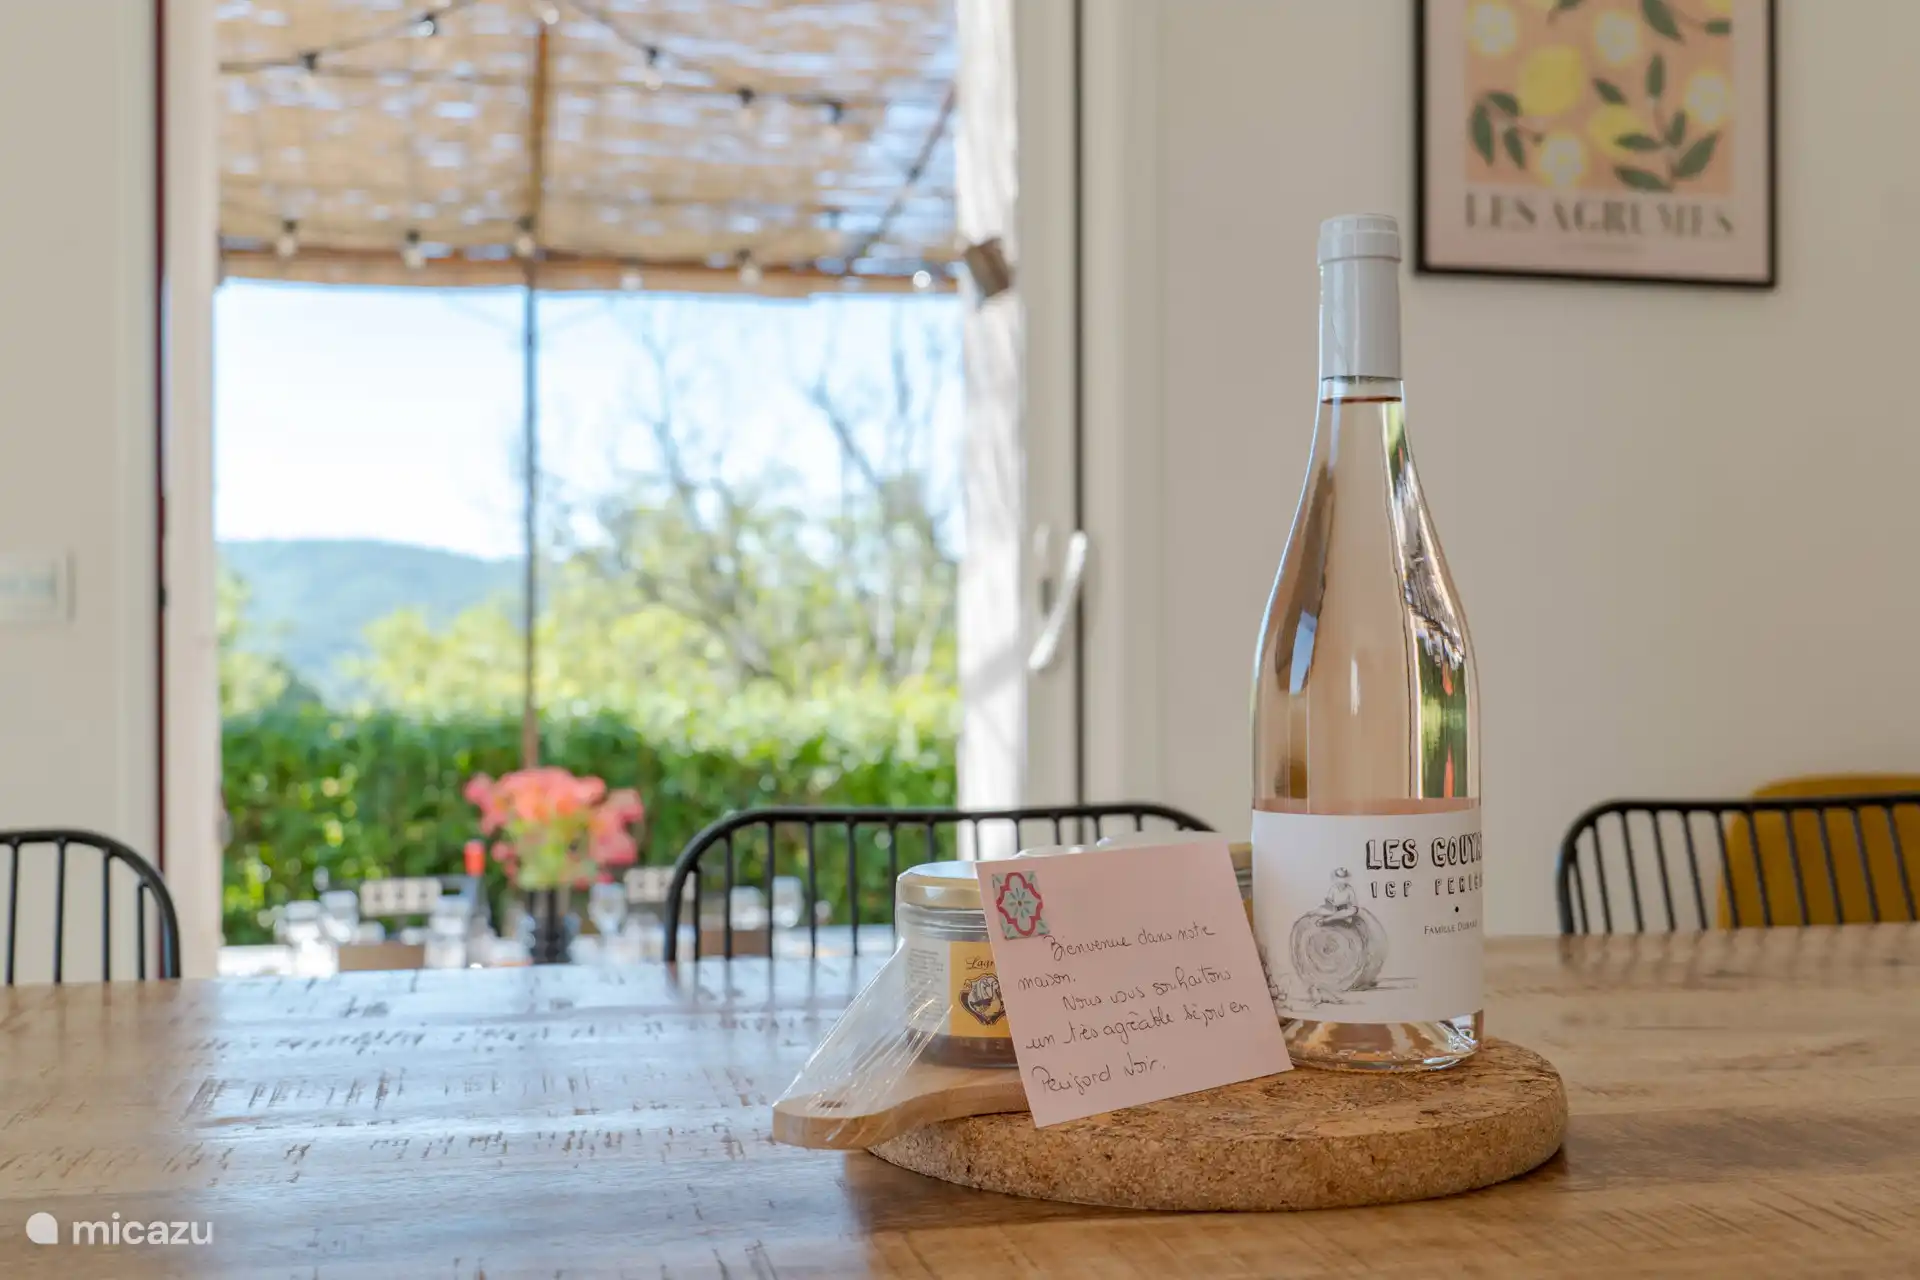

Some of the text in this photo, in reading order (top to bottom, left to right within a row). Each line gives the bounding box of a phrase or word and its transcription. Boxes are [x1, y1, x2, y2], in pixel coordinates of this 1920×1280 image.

[1465, 192, 1737, 238] LES AGRUMES
[1366, 838, 1419, 870] LES
[1371, 880, 1413, 898] IGP
[1044, 935, 1132, 961] Bienvenue
[1138, 926, 1172, 945] dans
[1062, 964, 1232, 1011] Nous vous souhaitons
[1026, 1034, 1056, 1049] un
[1229, 1001, 1250, 1013] en
